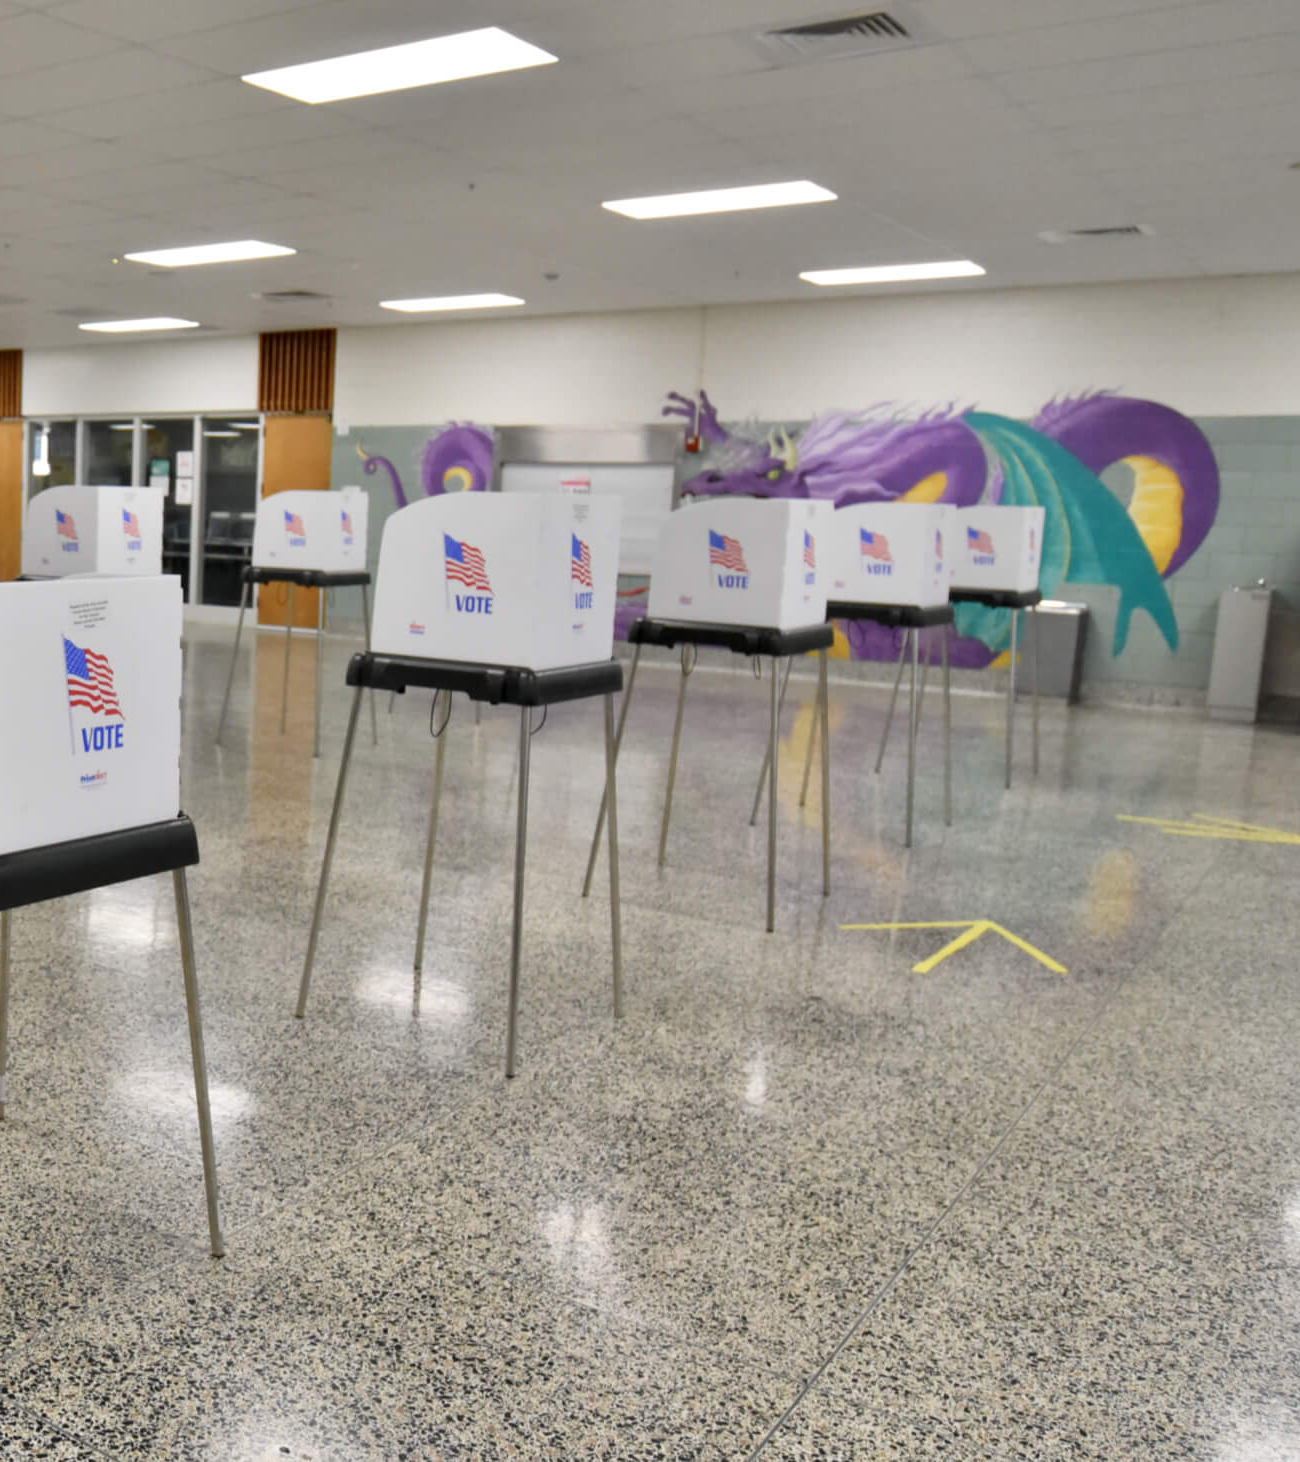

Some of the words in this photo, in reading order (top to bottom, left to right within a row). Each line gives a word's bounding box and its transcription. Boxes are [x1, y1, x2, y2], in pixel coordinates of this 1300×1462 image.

[867, 563, 892, 576] VOTE
[718, 574, 748, 589] VOTE
[456, 594, 493, 614] VOTE
[575, 592, 593, 609] VOTE
[81, 723, 125, 752] VOTE
